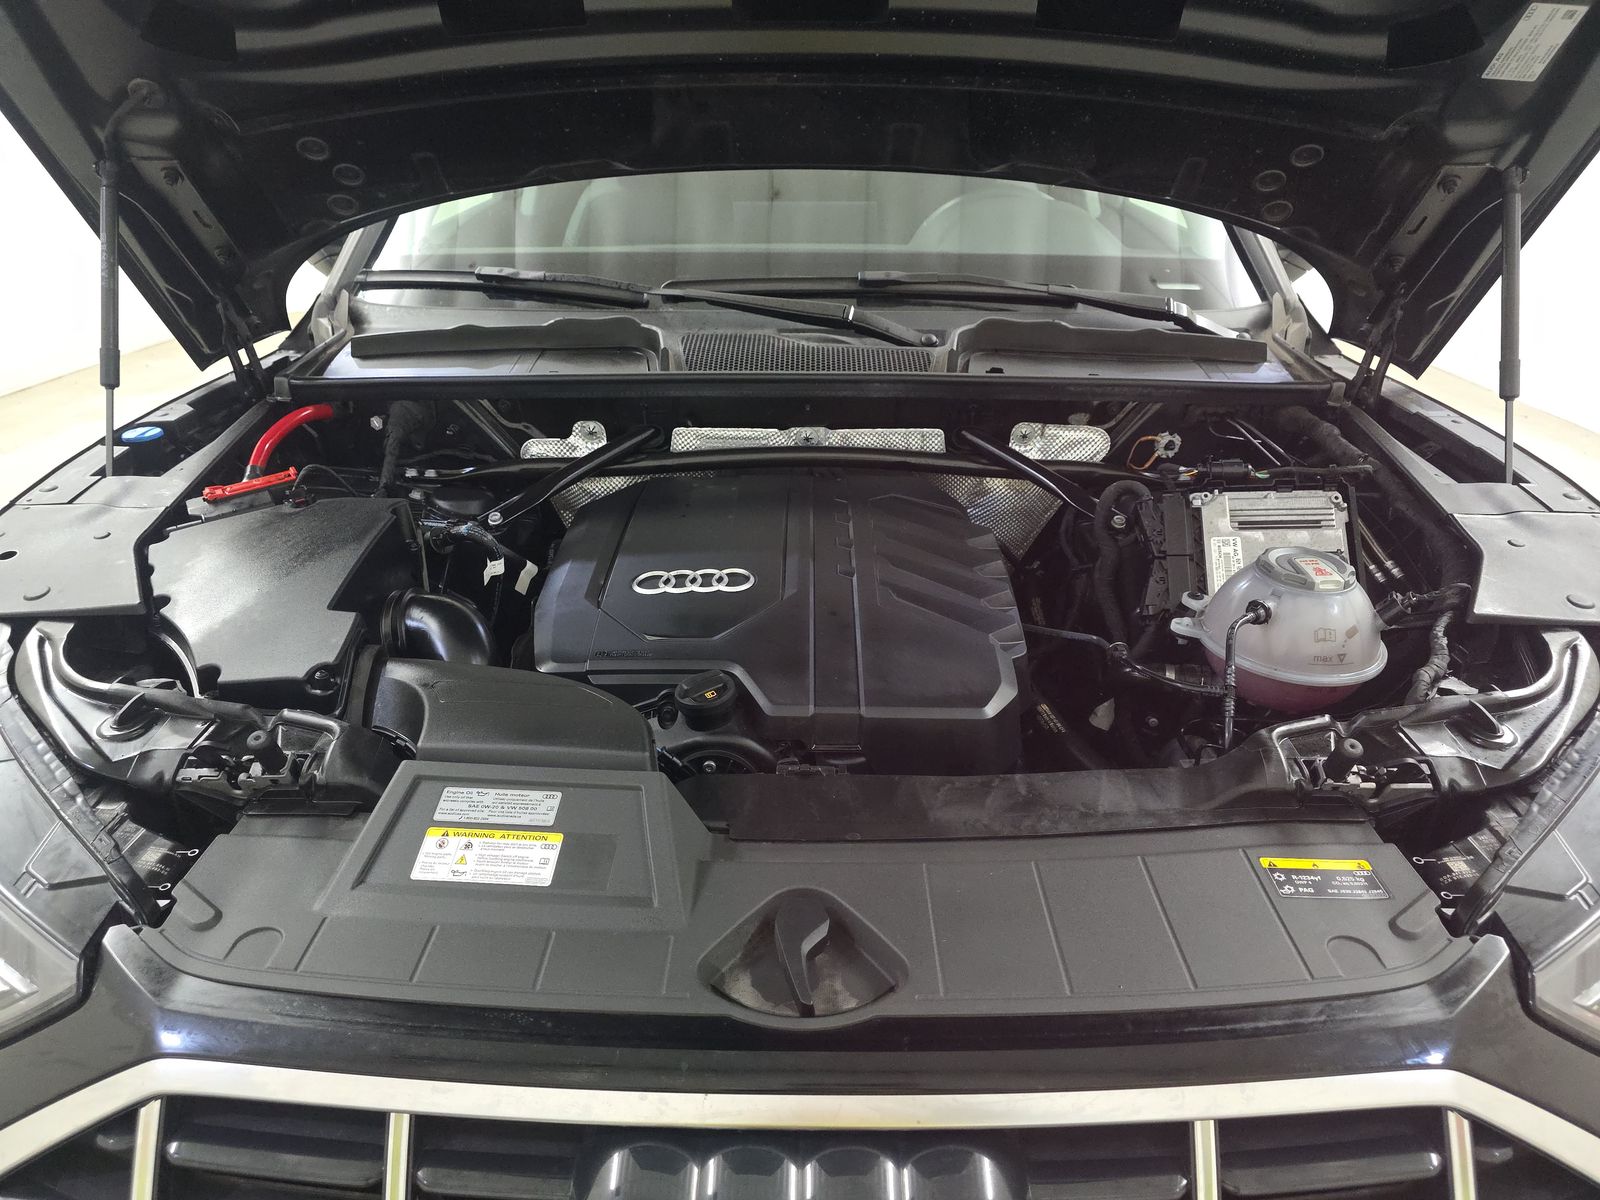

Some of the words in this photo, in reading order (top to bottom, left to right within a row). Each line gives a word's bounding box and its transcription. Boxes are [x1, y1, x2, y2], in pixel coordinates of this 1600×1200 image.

[1313, 655, 1333, 663] max
[452, 831, 495, 839] WARNING
[500, 833, 549, 842] ATTENTION
